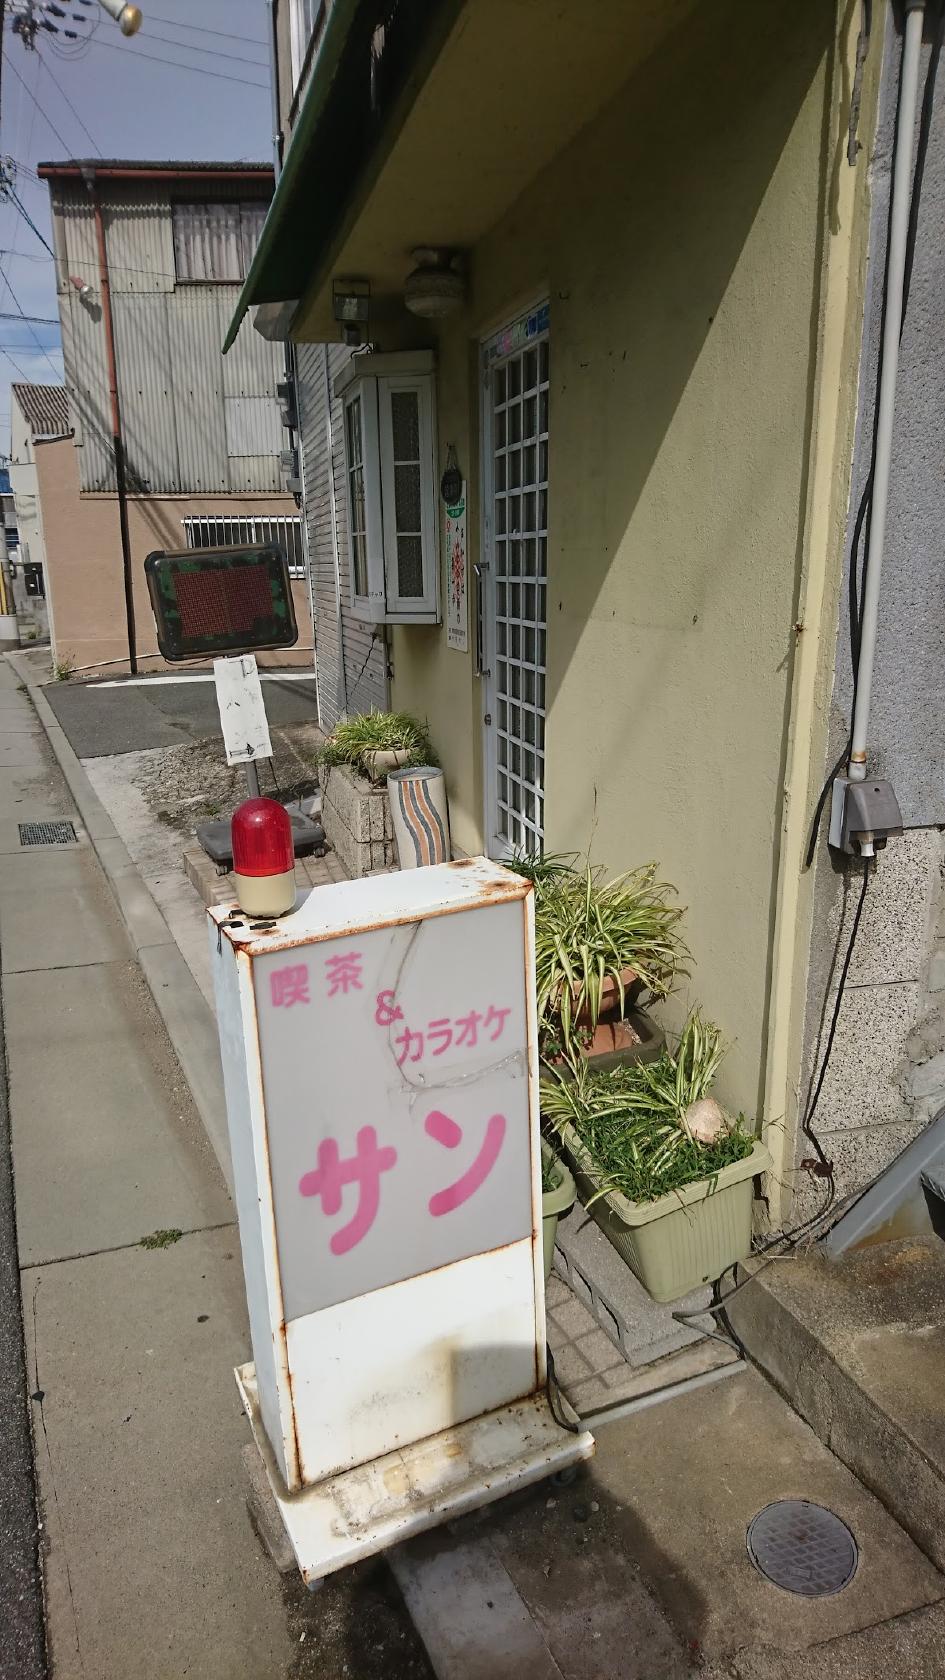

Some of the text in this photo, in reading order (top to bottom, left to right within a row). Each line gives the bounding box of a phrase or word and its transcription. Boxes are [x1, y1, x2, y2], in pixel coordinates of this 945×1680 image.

[270, 952, 364, 1008] 喫茶
[375, 989, 404, 1026] &
[395, 1005, 511, 1067] カラオケ
[299, 1110, 507, 1256] サン
